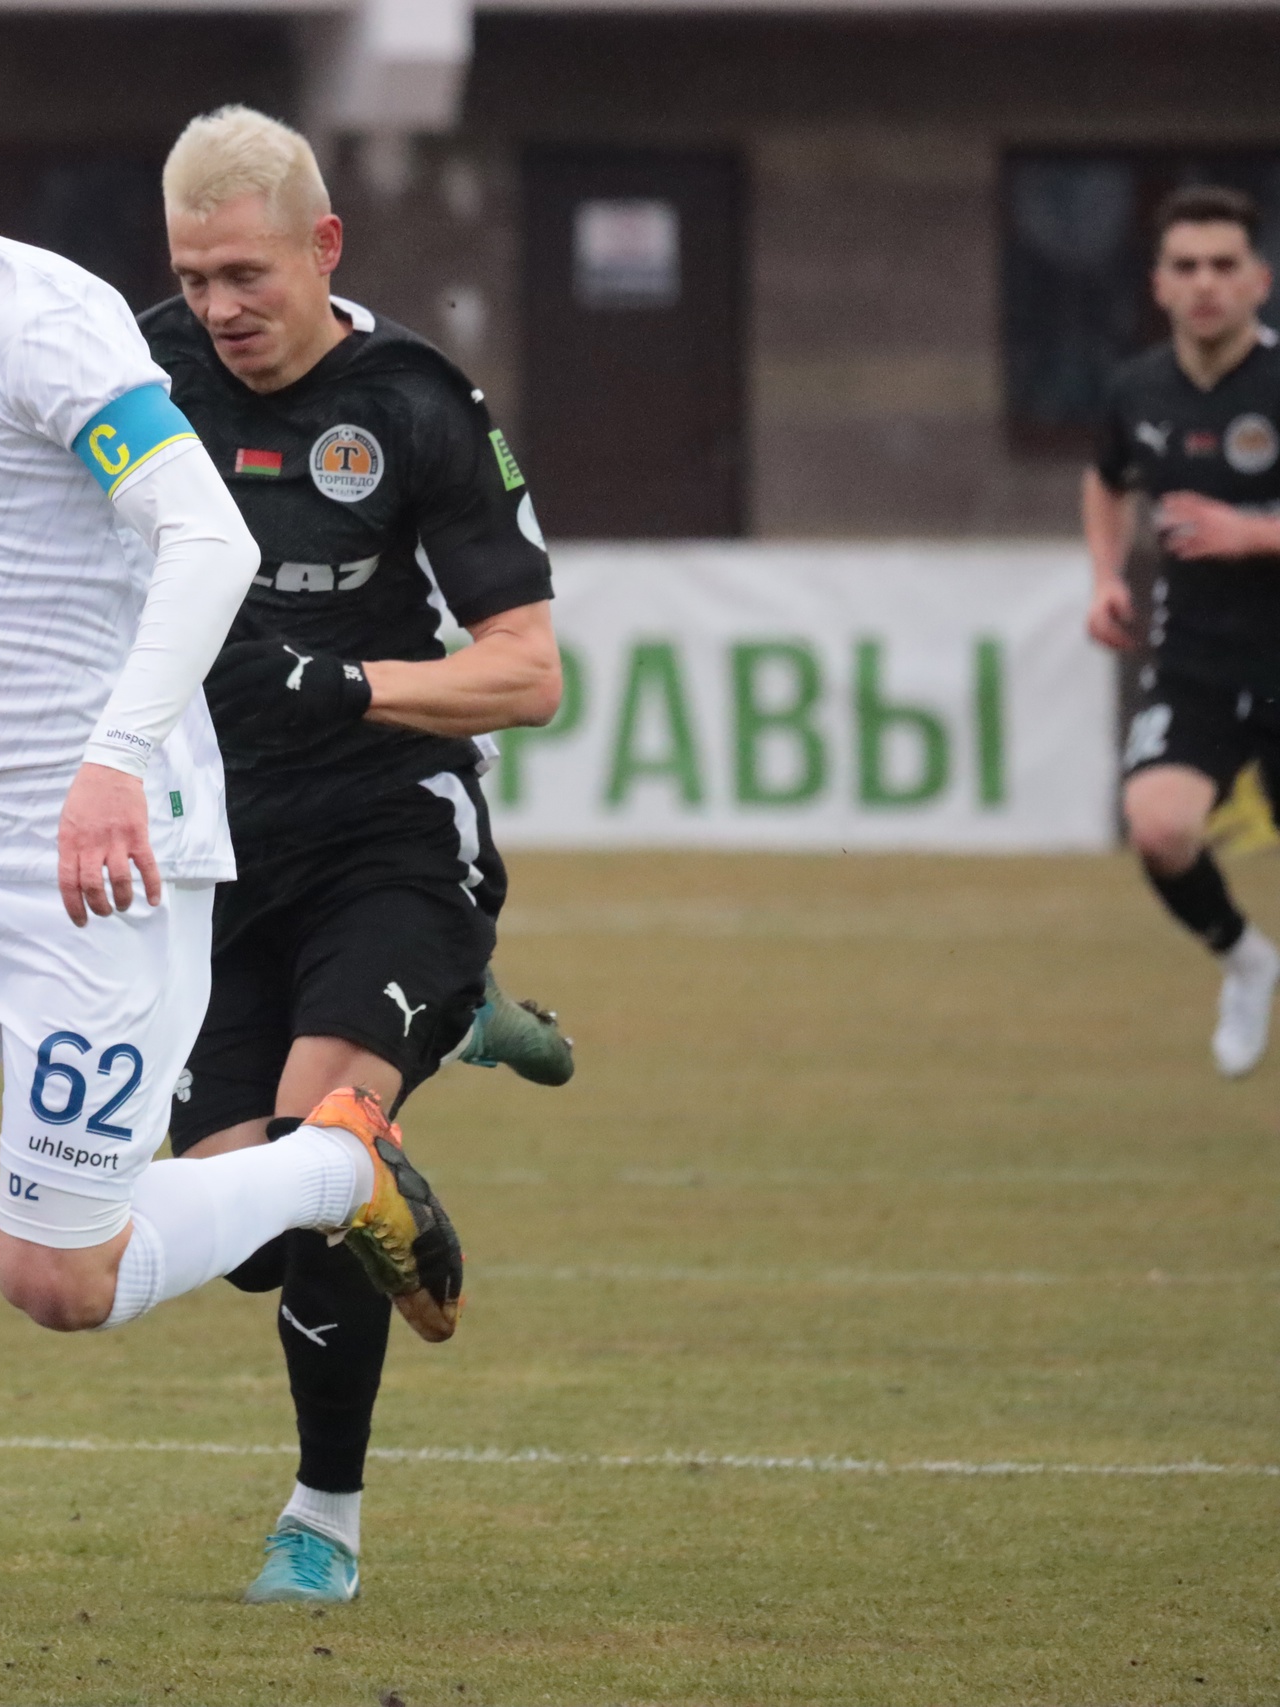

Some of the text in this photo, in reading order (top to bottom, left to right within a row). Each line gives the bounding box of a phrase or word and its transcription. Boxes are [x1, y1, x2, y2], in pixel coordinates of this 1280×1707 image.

[89, 424, 130, 476] C
[317, 474, 375, 488] ТОРПЕДО
[448, 636, 1010, 812] РАВЫ
[29, 1030, 144, 1142] 62
[28, 1135, 119, 1170] uhlsport
